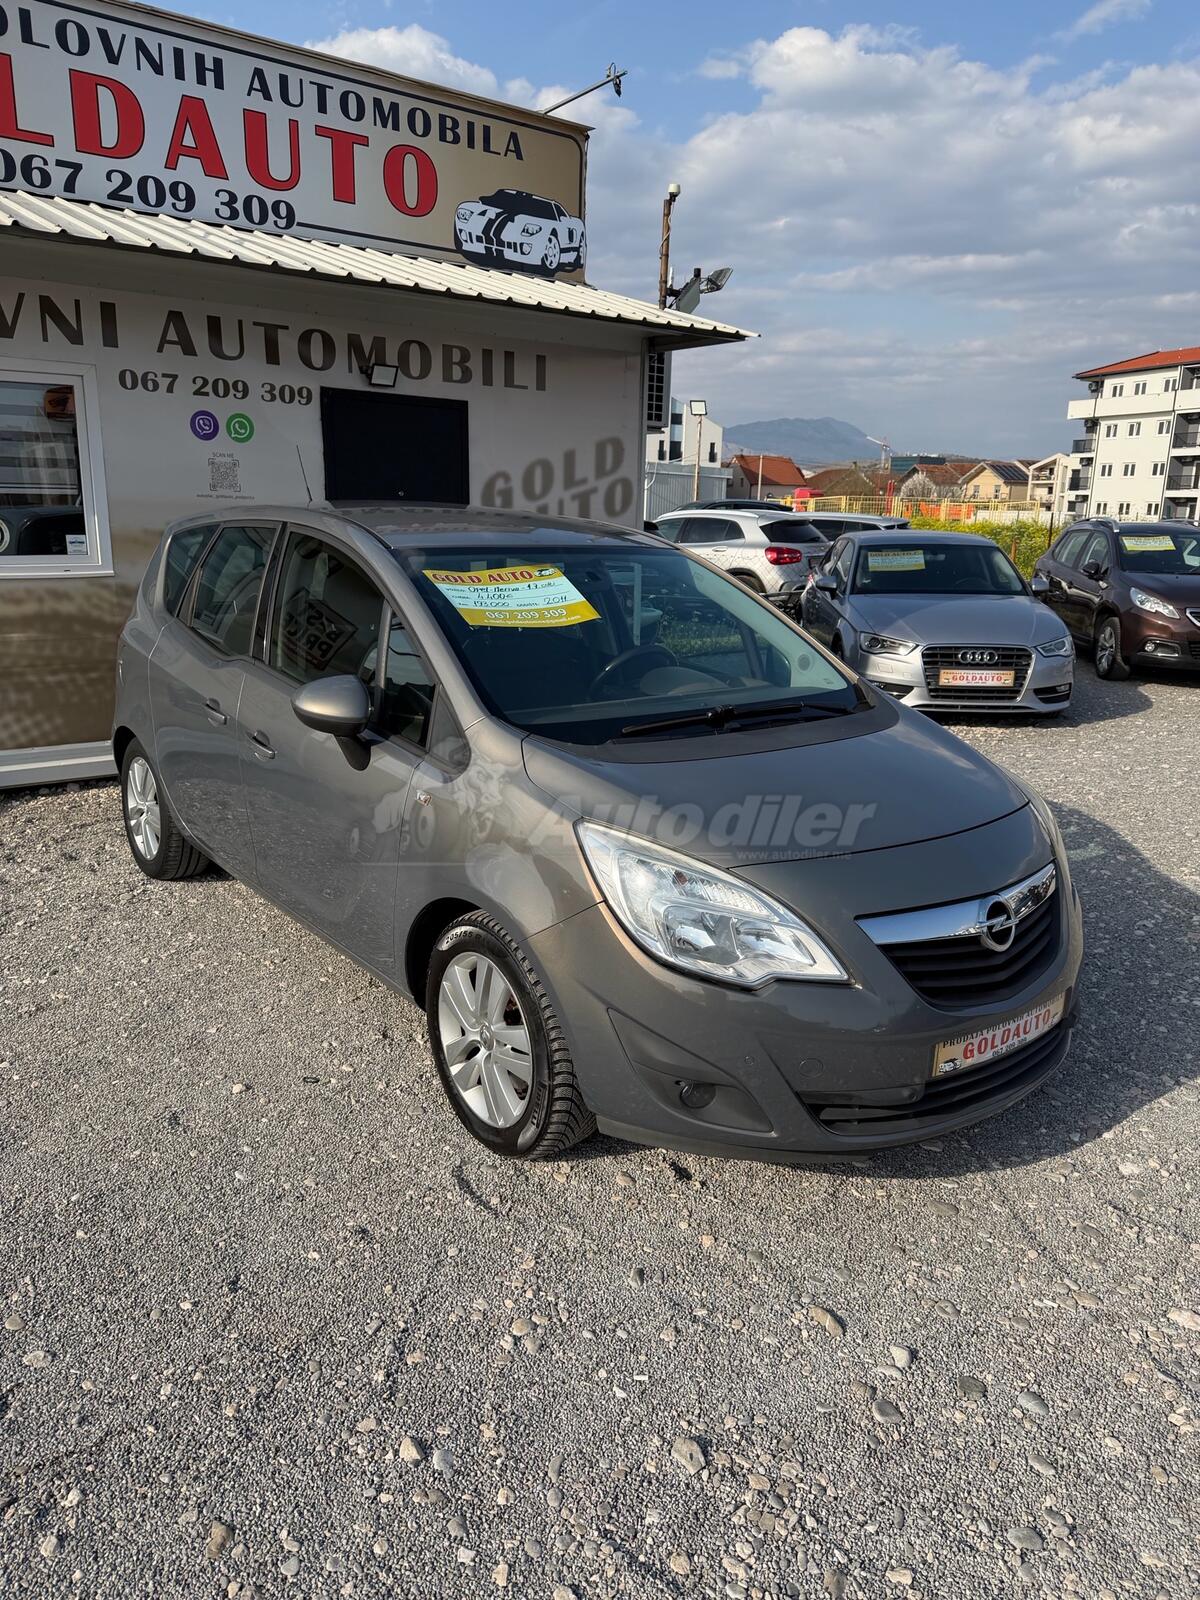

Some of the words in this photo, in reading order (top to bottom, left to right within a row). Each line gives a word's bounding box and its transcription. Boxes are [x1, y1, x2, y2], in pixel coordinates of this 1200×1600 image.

[0, 4, 225, 91] LOVNIH
[246, 67, 525, 162] AUTOMOBILA
[105, 169, 197, 213] 209
[214, 188, 296, 231] 309
[156, 309, 547, 392] AUTOMOBILI
[118, 368, 179, 394] 067
[192, 376, 249, 400] 209
[260, 382, 313, 406] 309
[480, 436, 625, 510] GOLD
[432, 573, 483, 584] GOLD
[487, 570, 534, 584] AUTO
[485, 611, 511, 619] 067
[513, 611, 540, 619] 209
[542, 608, 567, 618] 309
[943, 1027, 985, 1049] PRODAJA
[962, 1008, 1052, 1060] GOLDAUTO
